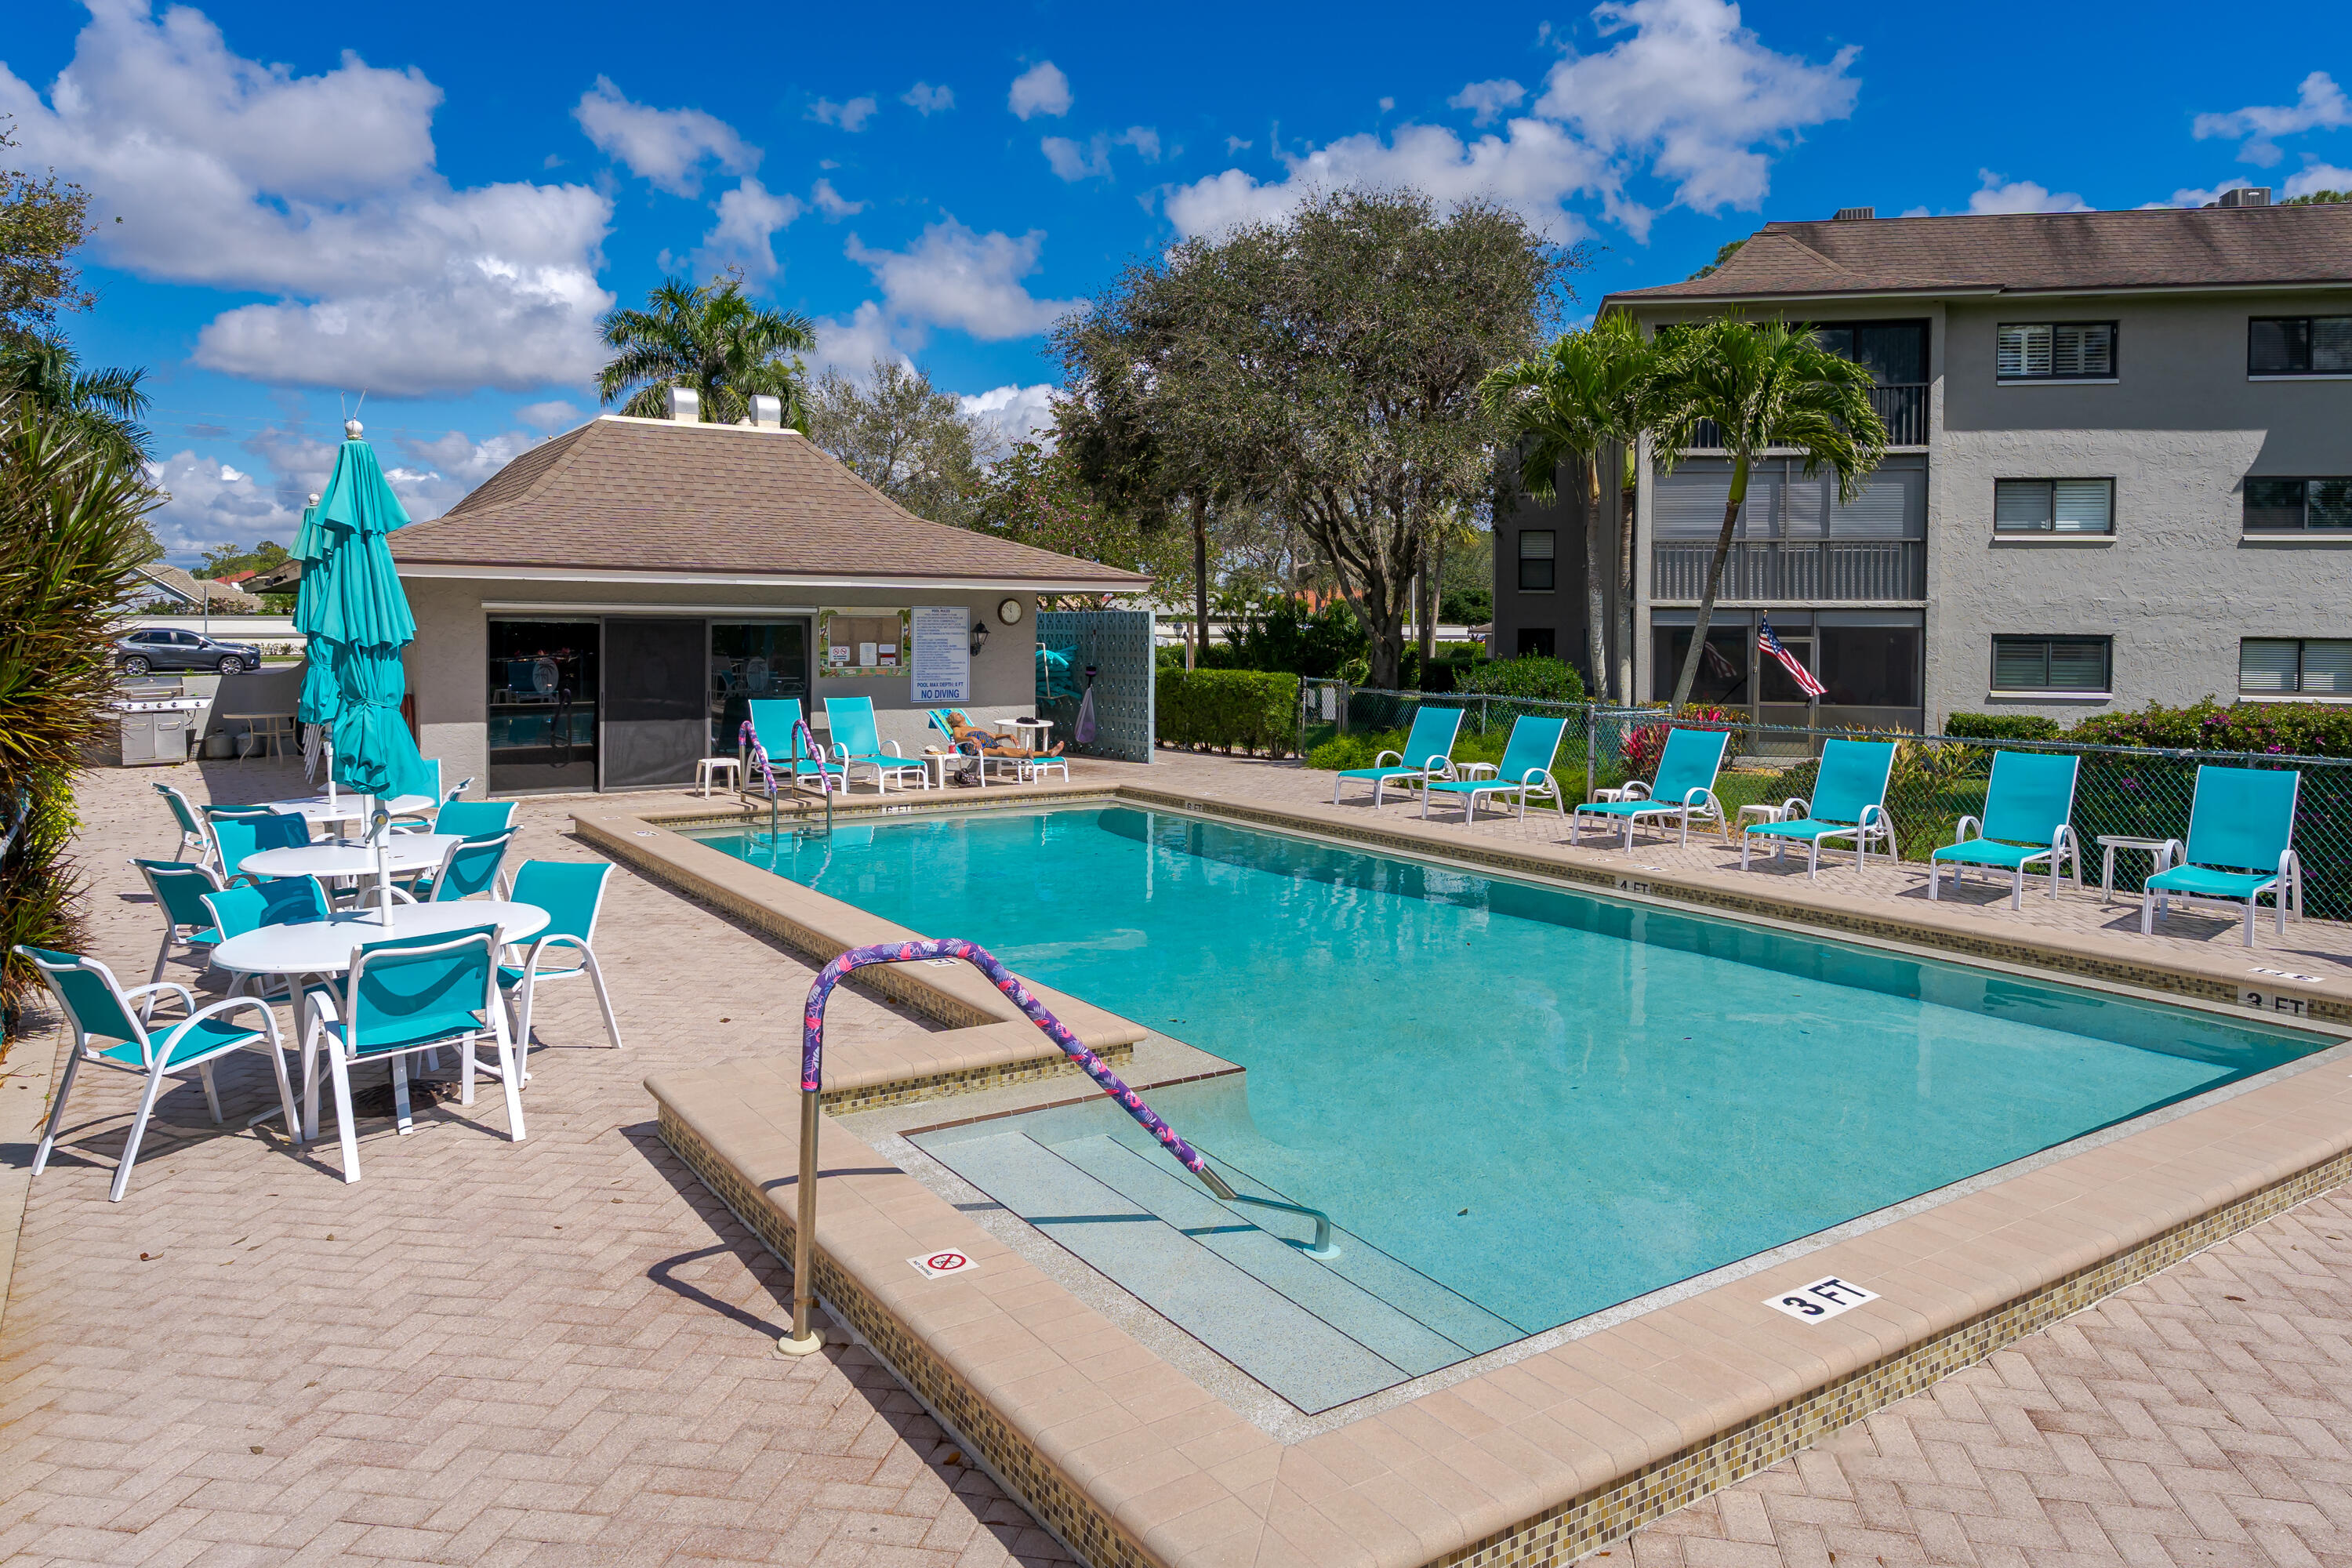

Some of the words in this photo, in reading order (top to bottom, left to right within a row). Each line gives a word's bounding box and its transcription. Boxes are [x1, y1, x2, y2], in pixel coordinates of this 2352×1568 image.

[921, 690, 933, 699] NO
[935, 689, 960, 698] DIVING
[1194, 804, 1202, 812] FT
[1633, 882, 1648, 893] FT
[2246, 992, 2263, 1006] 3
[2275, 996, 2305, 1014] FT
[1782, 1297, 1825, 1316] 3
[1807, 1279, 1867, 1305] FT
